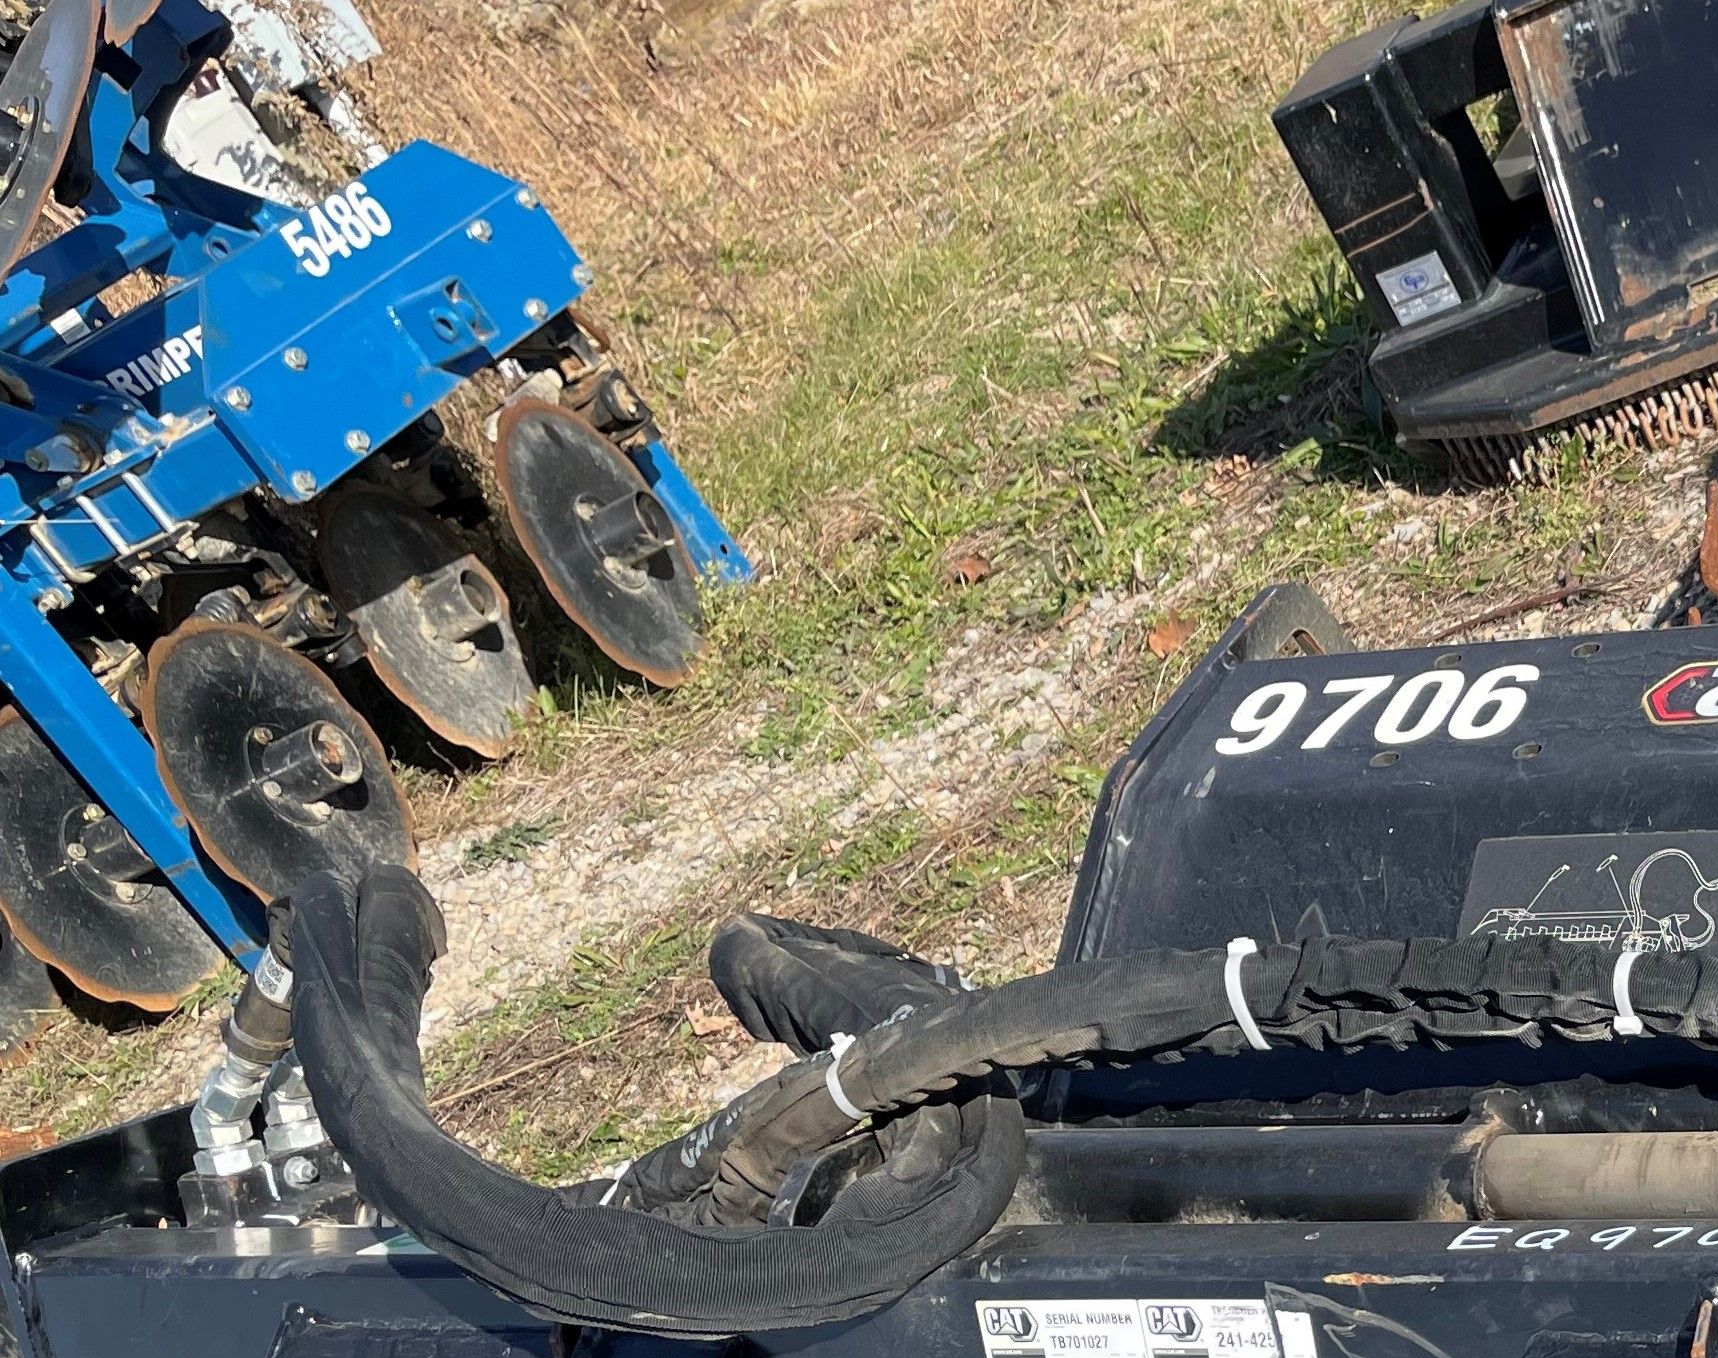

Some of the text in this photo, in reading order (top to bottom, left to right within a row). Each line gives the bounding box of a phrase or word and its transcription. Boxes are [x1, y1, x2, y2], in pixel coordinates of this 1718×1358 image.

[280, 181, 392, 277] 5486
[1215, 664, 1540, 755] 9706
[1447, 1226, 1570, 1250] EQ
[984, 1307, 1025, 1336] CAT
[1045, 1312, 1133, 1326] SERIAL NUMBER
[1146, 1305, 1188, 1335] CAT
[1050, 1335, 1109, 1349] TB701027
